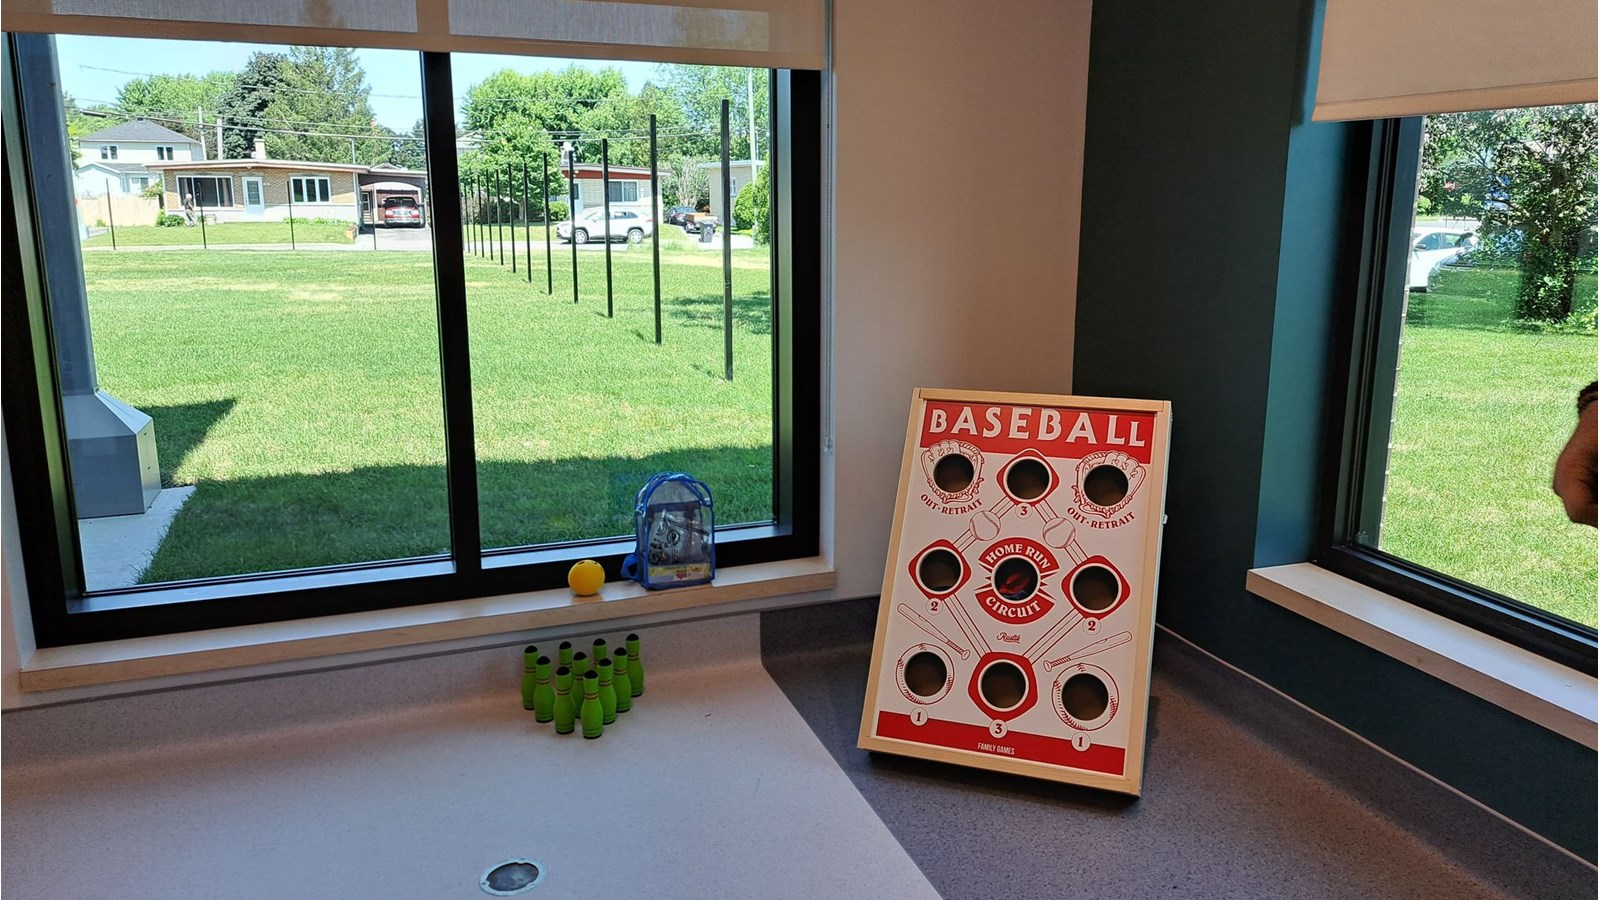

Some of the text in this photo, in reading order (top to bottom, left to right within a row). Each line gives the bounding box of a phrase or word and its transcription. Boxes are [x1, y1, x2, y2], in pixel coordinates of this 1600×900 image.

[929, 406, 1145, 447] BASEBALL
[1020, 505, 1028, 516] 3
[985, 544, 1051, 569] HOME RUN
[930, 601, 939, 612] 2
[985, 596, 1041, 617] CIRCUIT
[1087, 620, 1096, 631] 2
[916, 711, 922, 722] 1
[994, 723, 1003, 734] 3
[1078, 736, 1084, 747] 1
[977, 742, 1015, 755] FAMILY GAMES
